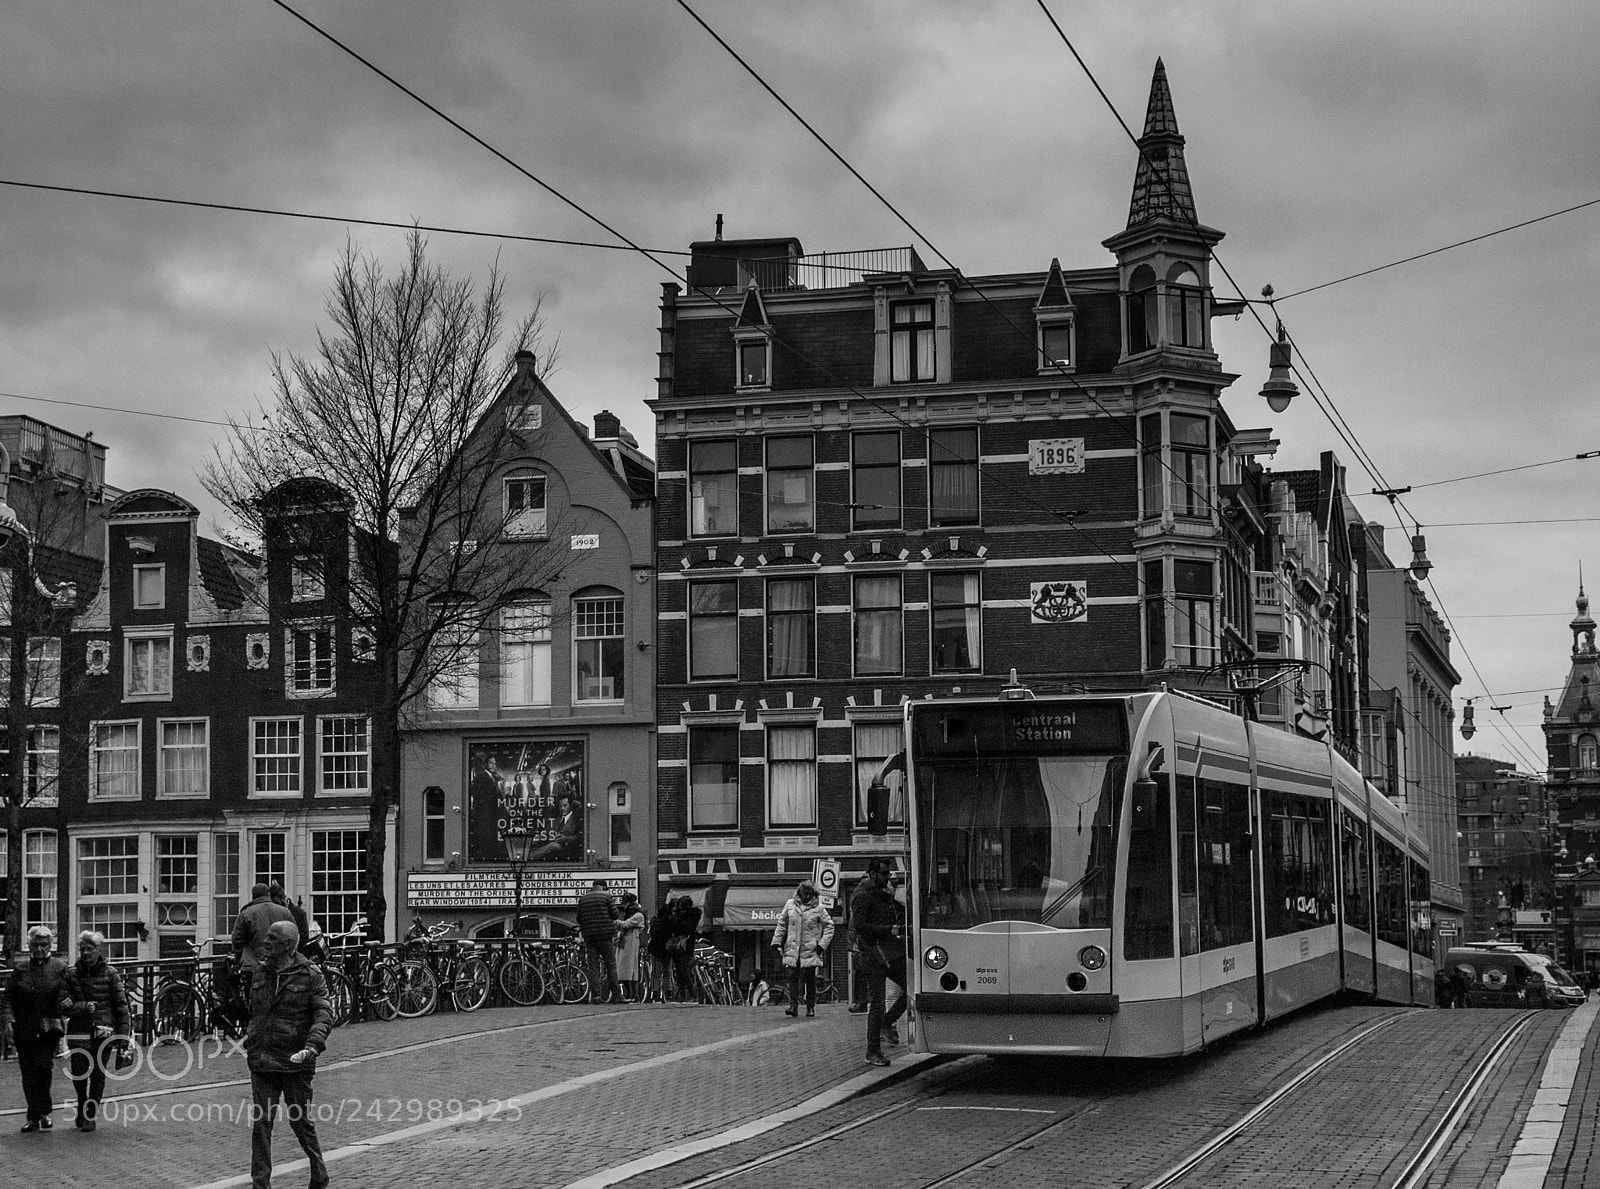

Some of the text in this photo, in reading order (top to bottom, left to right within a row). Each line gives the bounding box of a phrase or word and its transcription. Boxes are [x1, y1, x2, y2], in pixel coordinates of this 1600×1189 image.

[1039, 447, 1075, 465] 1896
[940, 716, 948, 743] 1
[1016, 727, 1072, 740] Station
[497, 797, 555, 808] MURDER
[509, 809, 544, 817] ON THE
[977, 976, 997, 984] 2069
